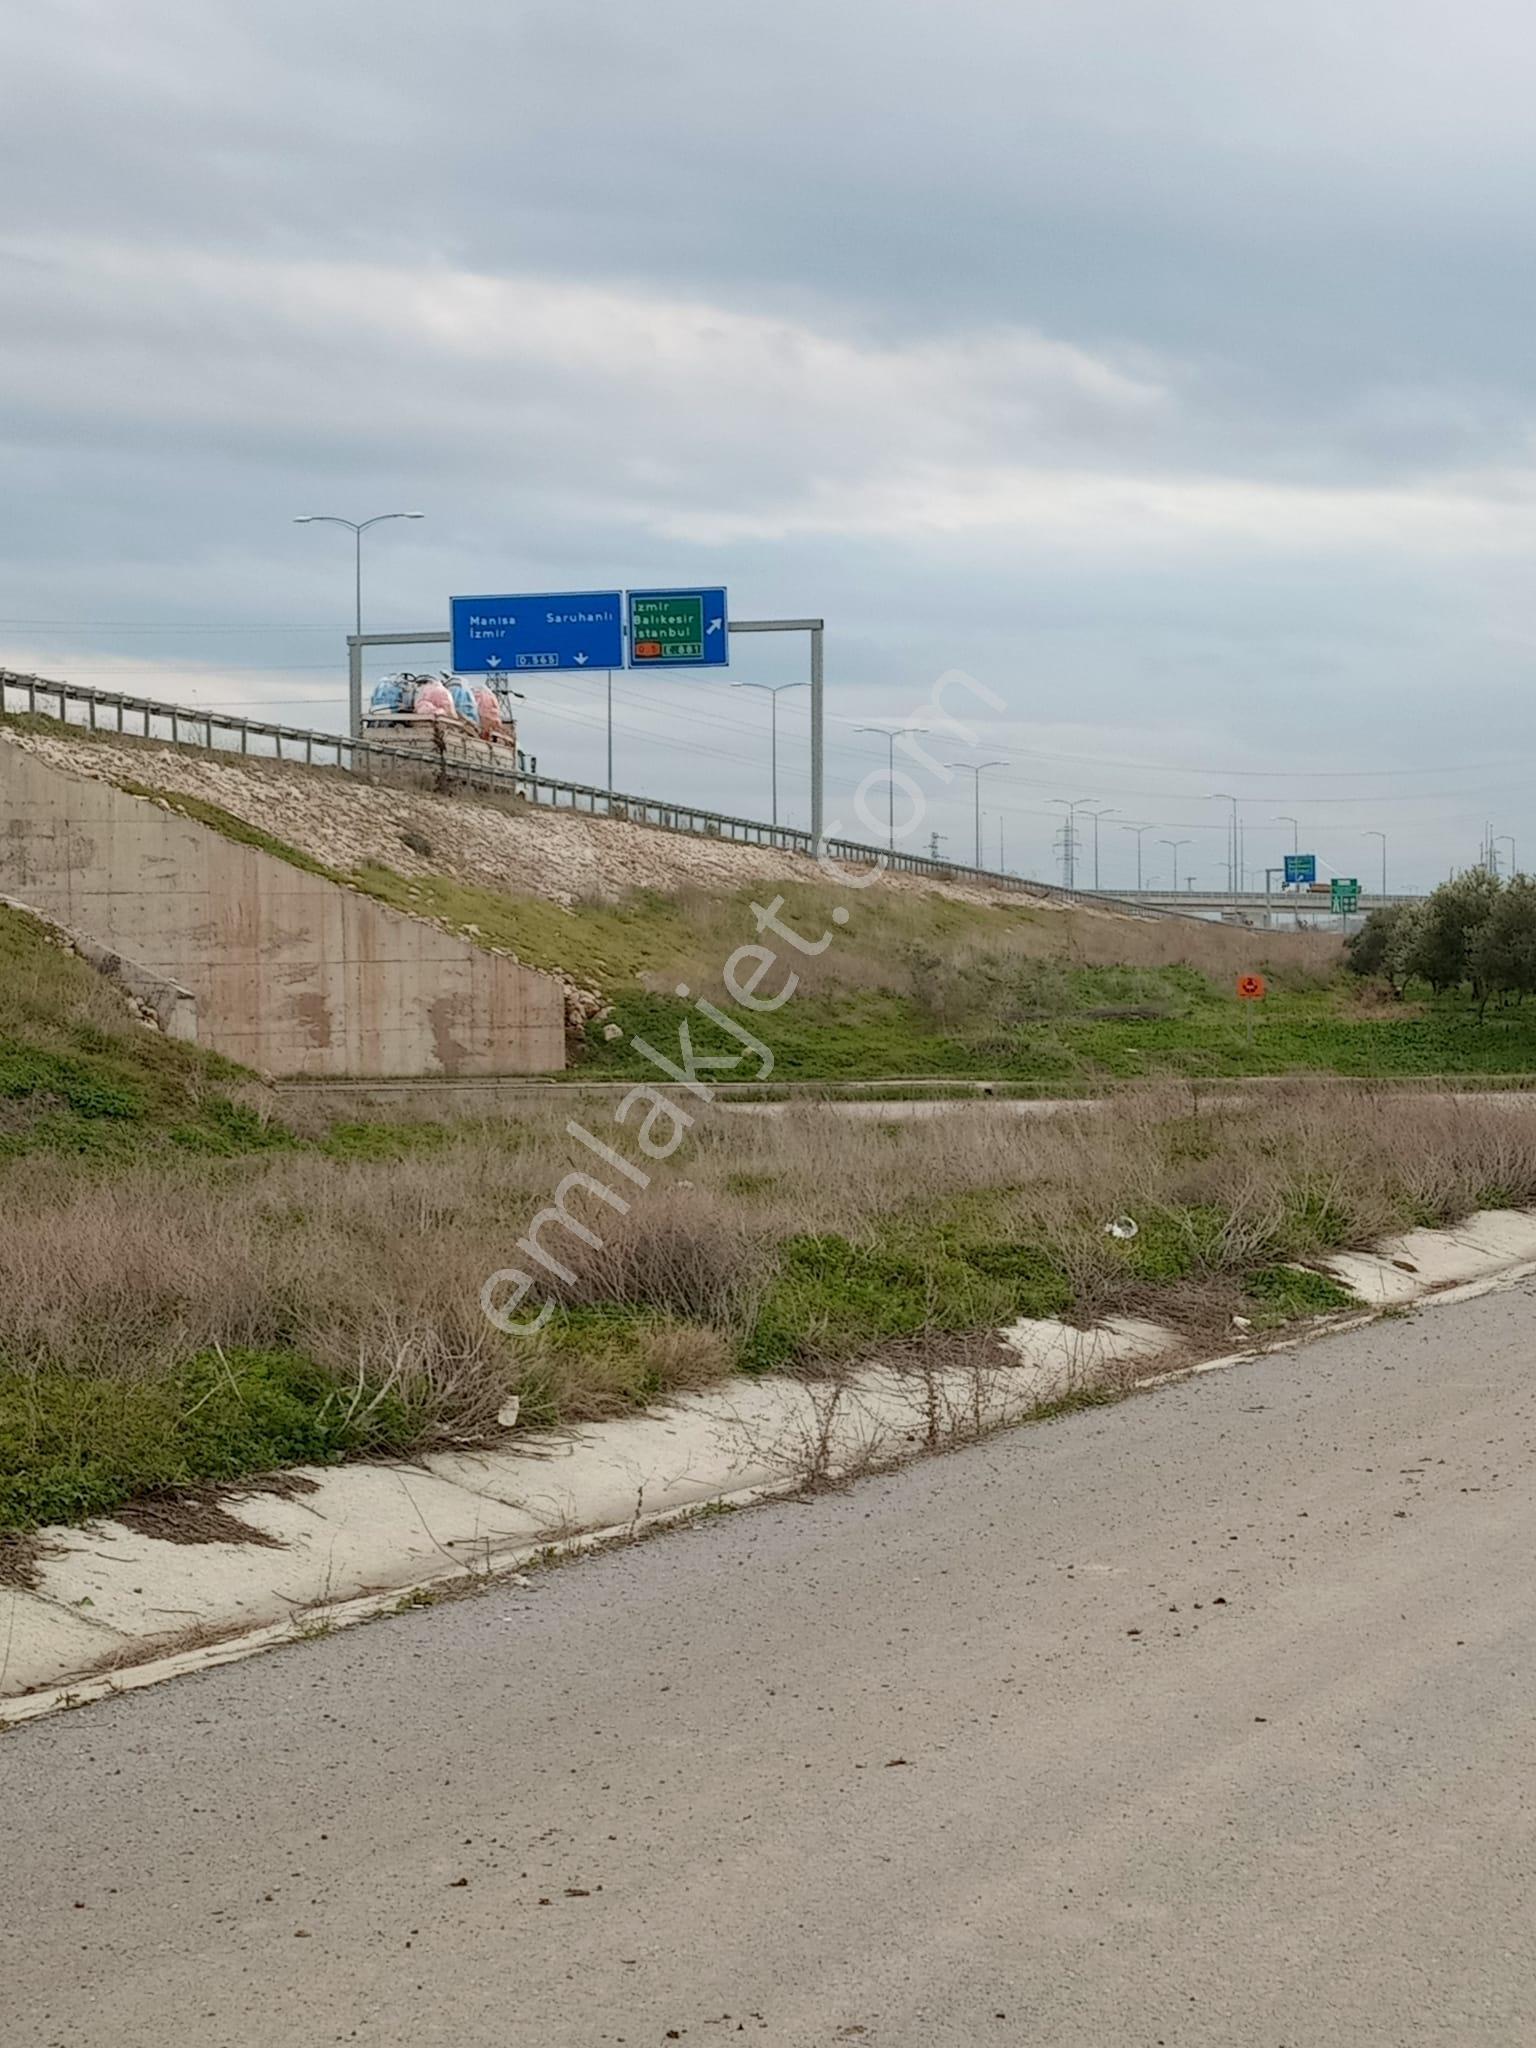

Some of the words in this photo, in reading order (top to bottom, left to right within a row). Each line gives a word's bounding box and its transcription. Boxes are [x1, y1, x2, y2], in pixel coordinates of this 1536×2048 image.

[470, 616, 516, 626] Manisa
[546, 611, 613, 624] Saruhanlı
[470, 627, 506, 639] İzmir
